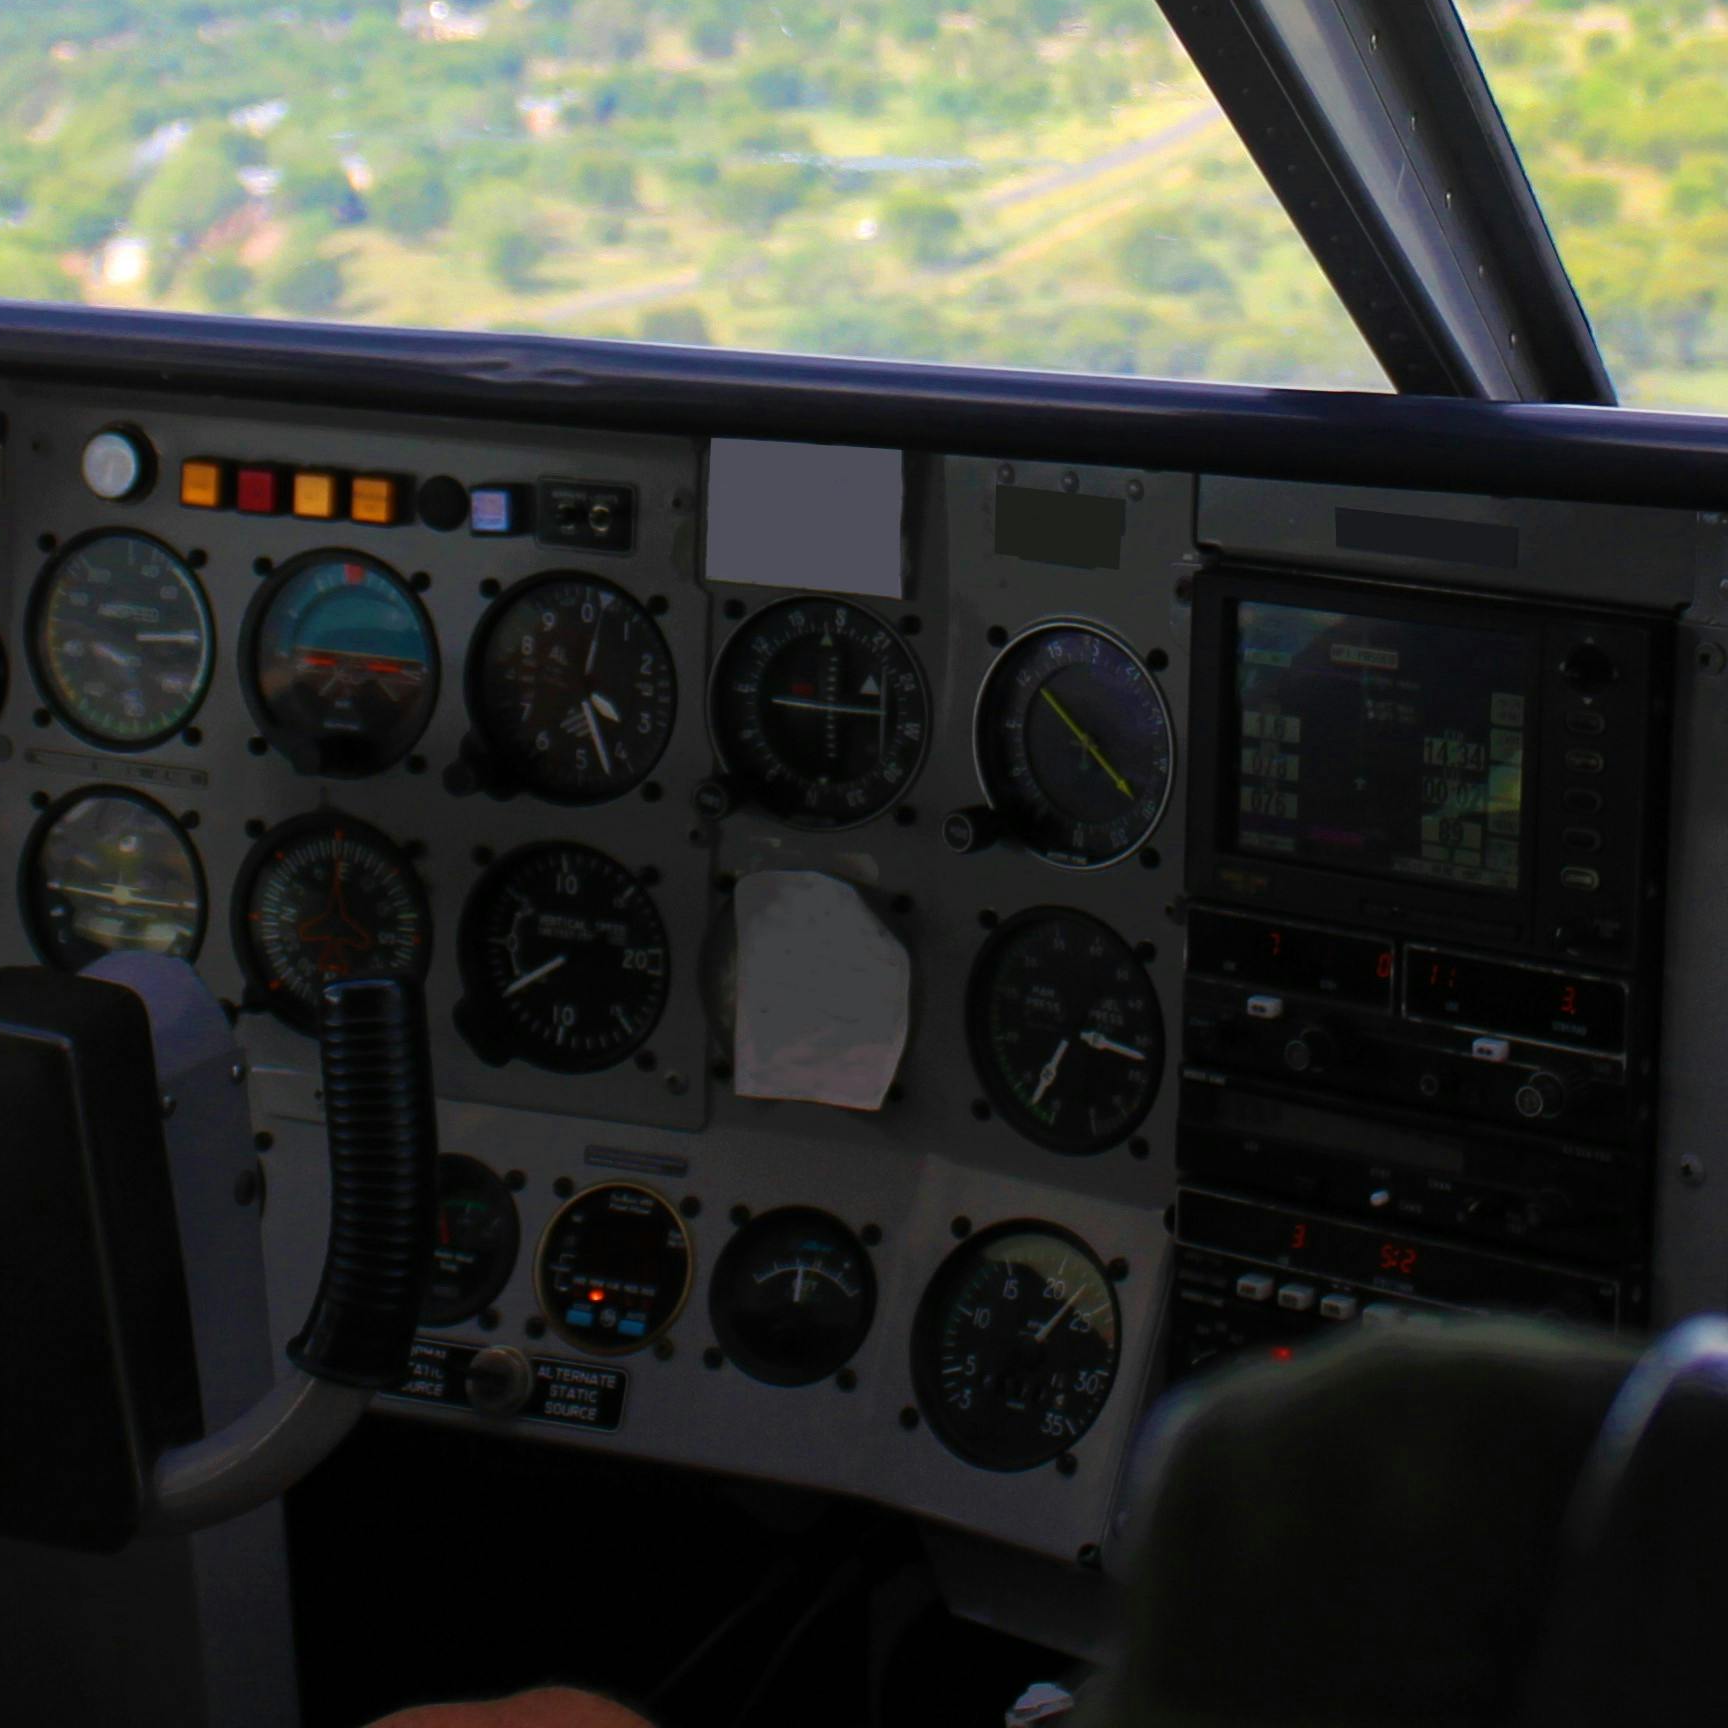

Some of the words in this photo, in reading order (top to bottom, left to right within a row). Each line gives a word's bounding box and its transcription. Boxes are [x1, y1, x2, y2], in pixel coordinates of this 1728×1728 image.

[541, 611, 557, 632] 9
[580, 602, 594, 623] 0
[787, 609, 805, 628] 15
[622, 620, 630, 642] 1
[871, 630, 891, 651] 21
[521, 635, 535, 656] 8
[1047, 641, 1063, 658] 15
[639, 653, 655, 676] 2
[520, 702, 532, 723] 7
[637, 712, 652, 735] 3
[535, 730, 550, 751] 6
[614, 740, 628, 760] 4
[575, 748, 588, 770] 5
[555, 874, 579, 895] 10
[280, 906, 298, 923] N
[622, 947, 648, 970] 20
[552, 1003, 576, 1026] 10
[1002, 1280, 1018, 1300] 15
[1042, 1276, 1066, 1300] 20
[973, 1306, 990, 1329] 10
[1068, 1310, 1092, 1334] 25
[964, 1354, 977, 1375] 5
[536, 1364, 618, 1390] ALTERNATE
[1073, 1369, 1099, 1394] 30
[548, 1384, 599, 1404] STATIC
[543, 1400, 600, 1422] SOURCE
[1040, 1411, 1064, 1436] 35
